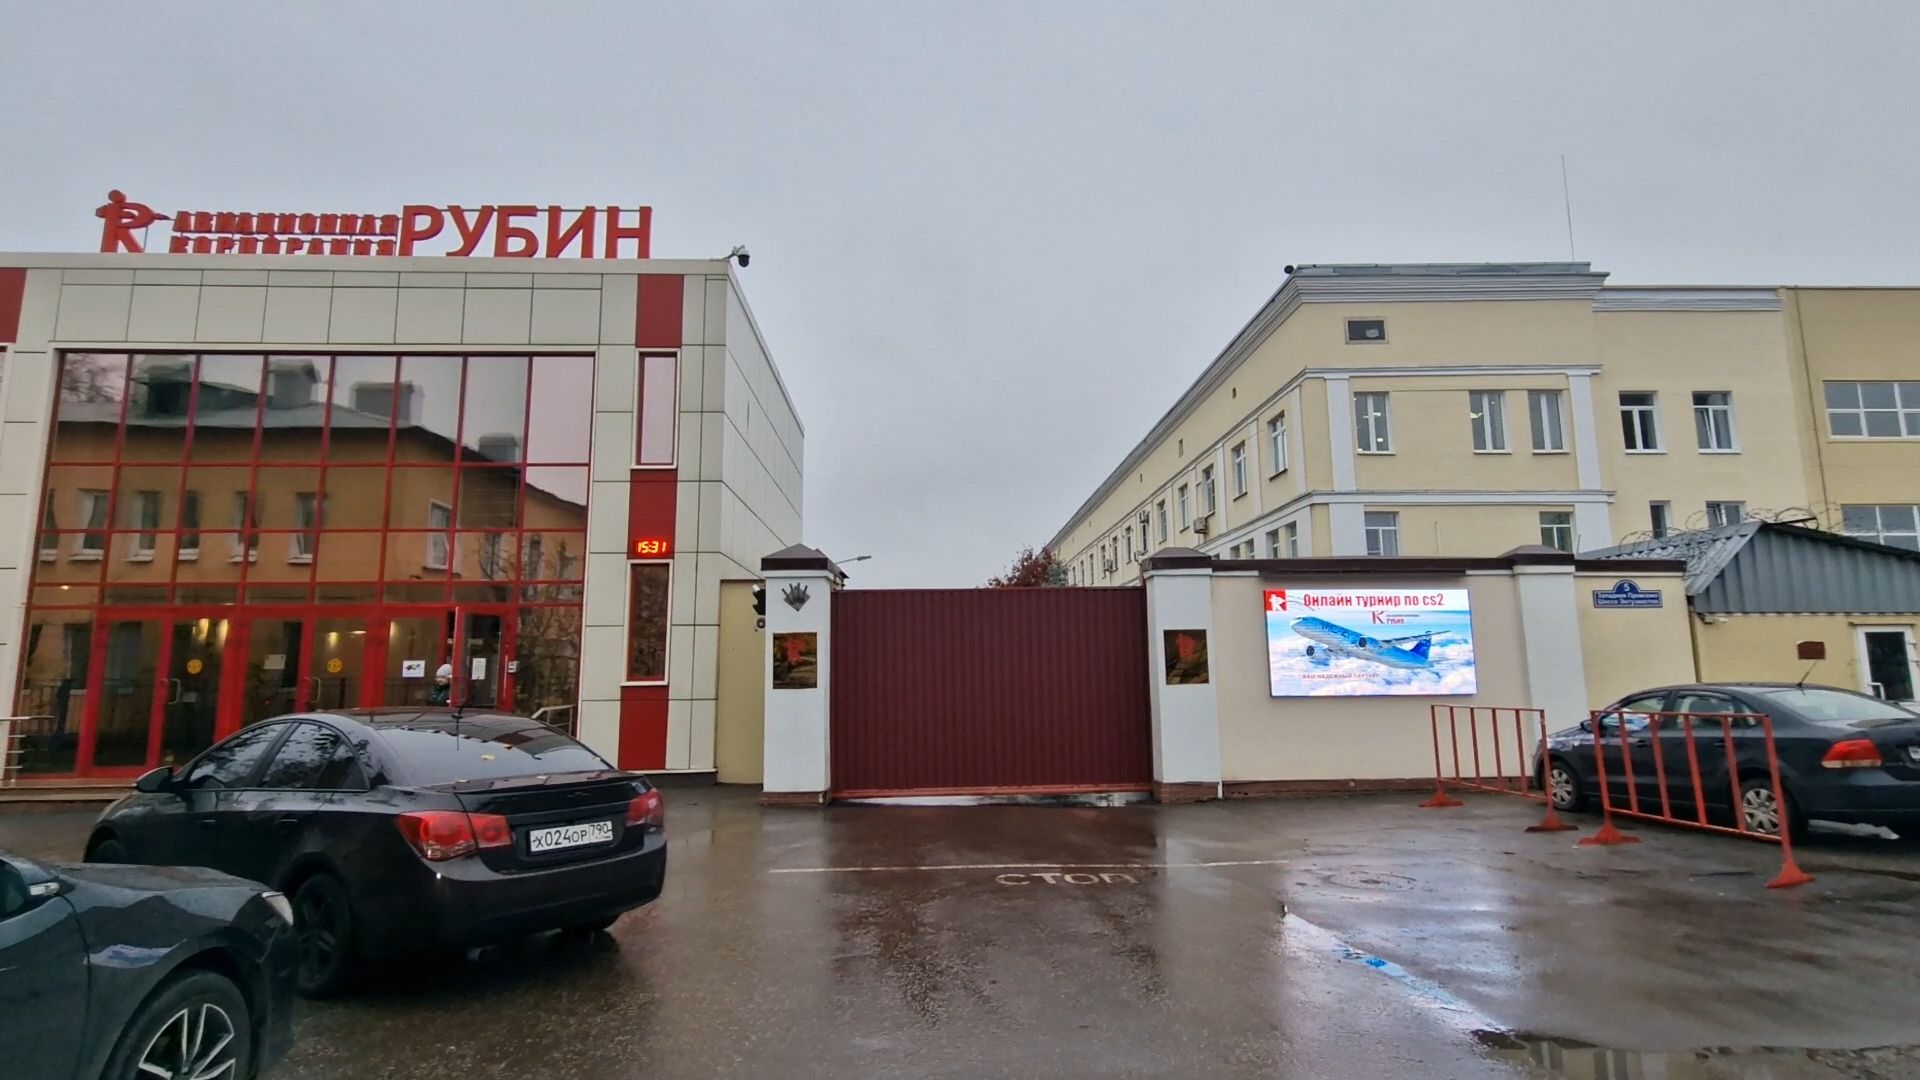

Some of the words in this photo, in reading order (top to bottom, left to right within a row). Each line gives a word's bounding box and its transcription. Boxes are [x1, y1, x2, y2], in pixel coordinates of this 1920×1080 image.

[173, 211, 398, 237] АВИАЦИОННАЯ
[399, 205, 652, 258] РУБИН
[169, 236, 396, 255] КОРПОРАЦИЯ
[637, 541, 667, 553] 15:31
[1624, 583, 1630, 591] 5
[1303, 594, 1352, 607] Онлайн
[1357, 595, 1400, 608] турнир
[1404, 595, 1419, 606] по
[1422, 594, 1444, 606] cs2
[589, 823, 609, 836] 790
[995, 872, 1139, 885] СТОП
